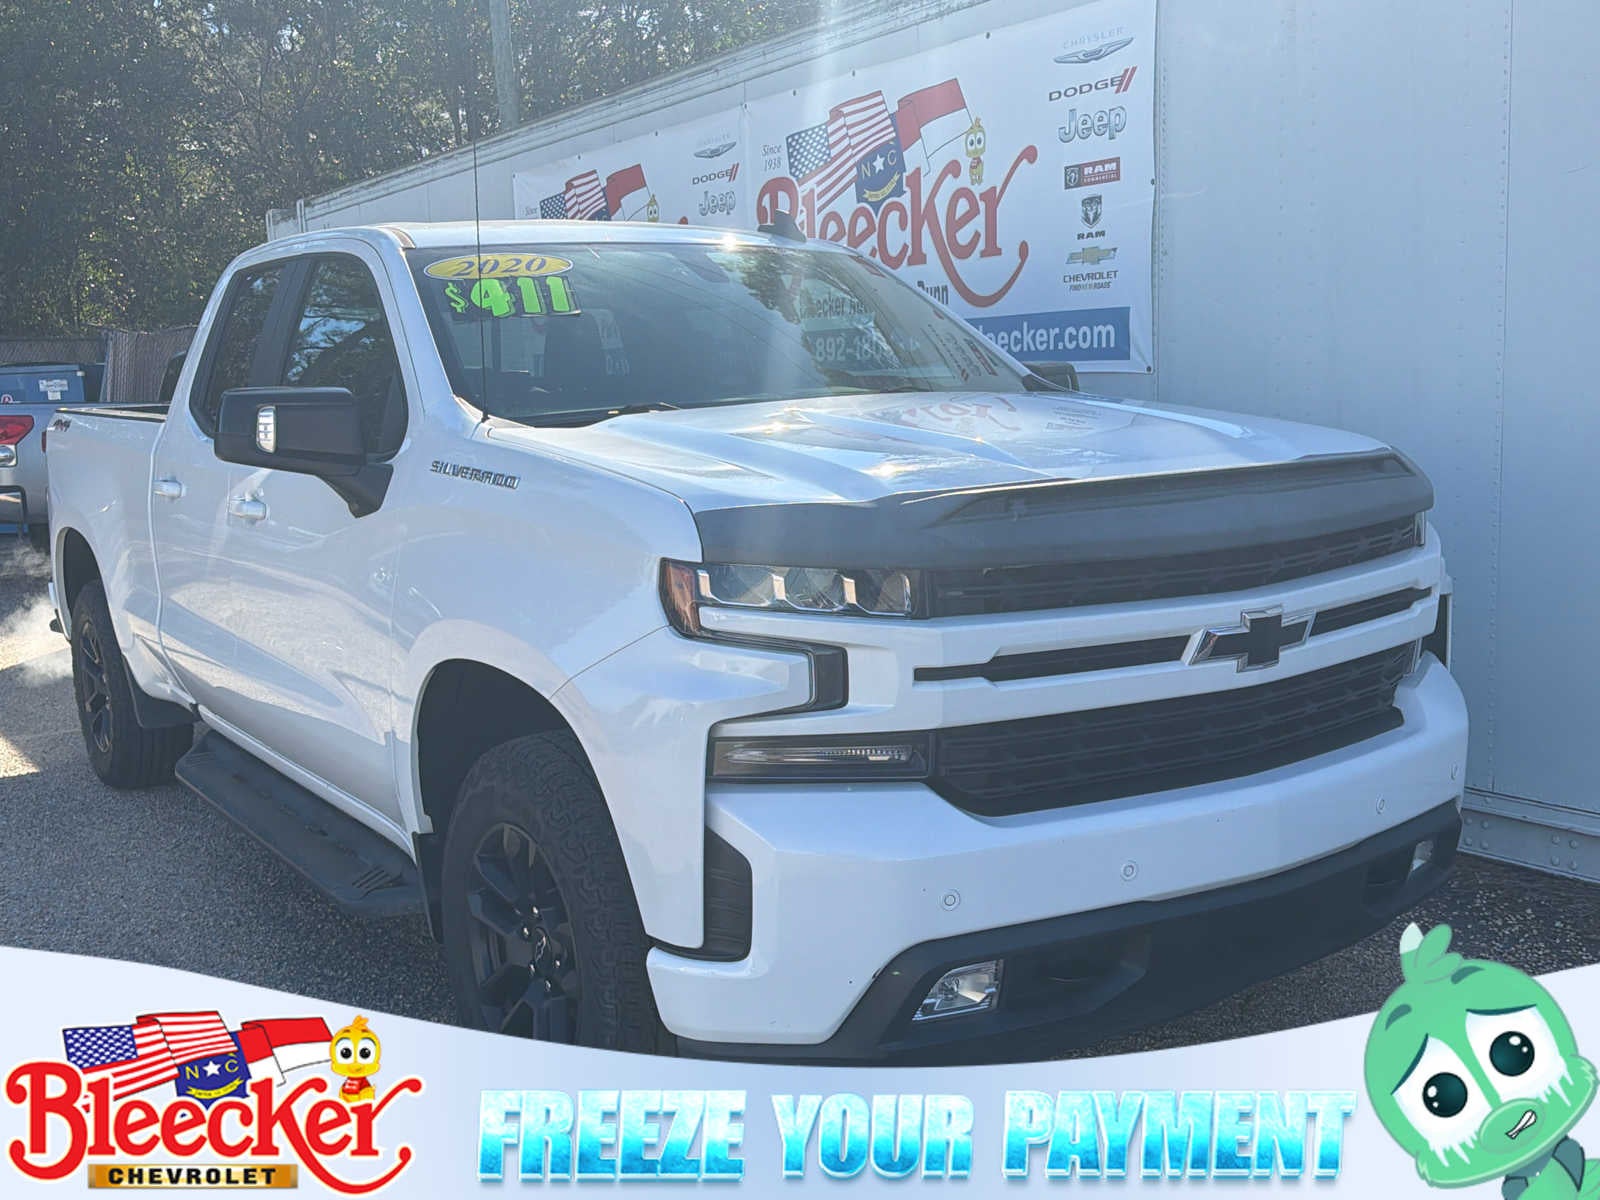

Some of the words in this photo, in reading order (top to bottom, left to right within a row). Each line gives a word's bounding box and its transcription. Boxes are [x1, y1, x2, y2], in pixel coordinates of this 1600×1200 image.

[1048, 75, 1123, 102] DODGE
[1058, 105, 1127, 143] Jeep
[692, 168, 732, 185] DODGE
[861, 161, 871, 180] N
[887, 150, 897, 166] C
[1083, 162, 1117, 176] RAM
[699, 190, 736, 217] Jeep
[1077, 230, 1106, 240] RAM
[453, 257, 547, 277] 2020
[1063, 270, 1119, 283] CHEVROLET
[430, 460, 520, 490] SILVERADO
